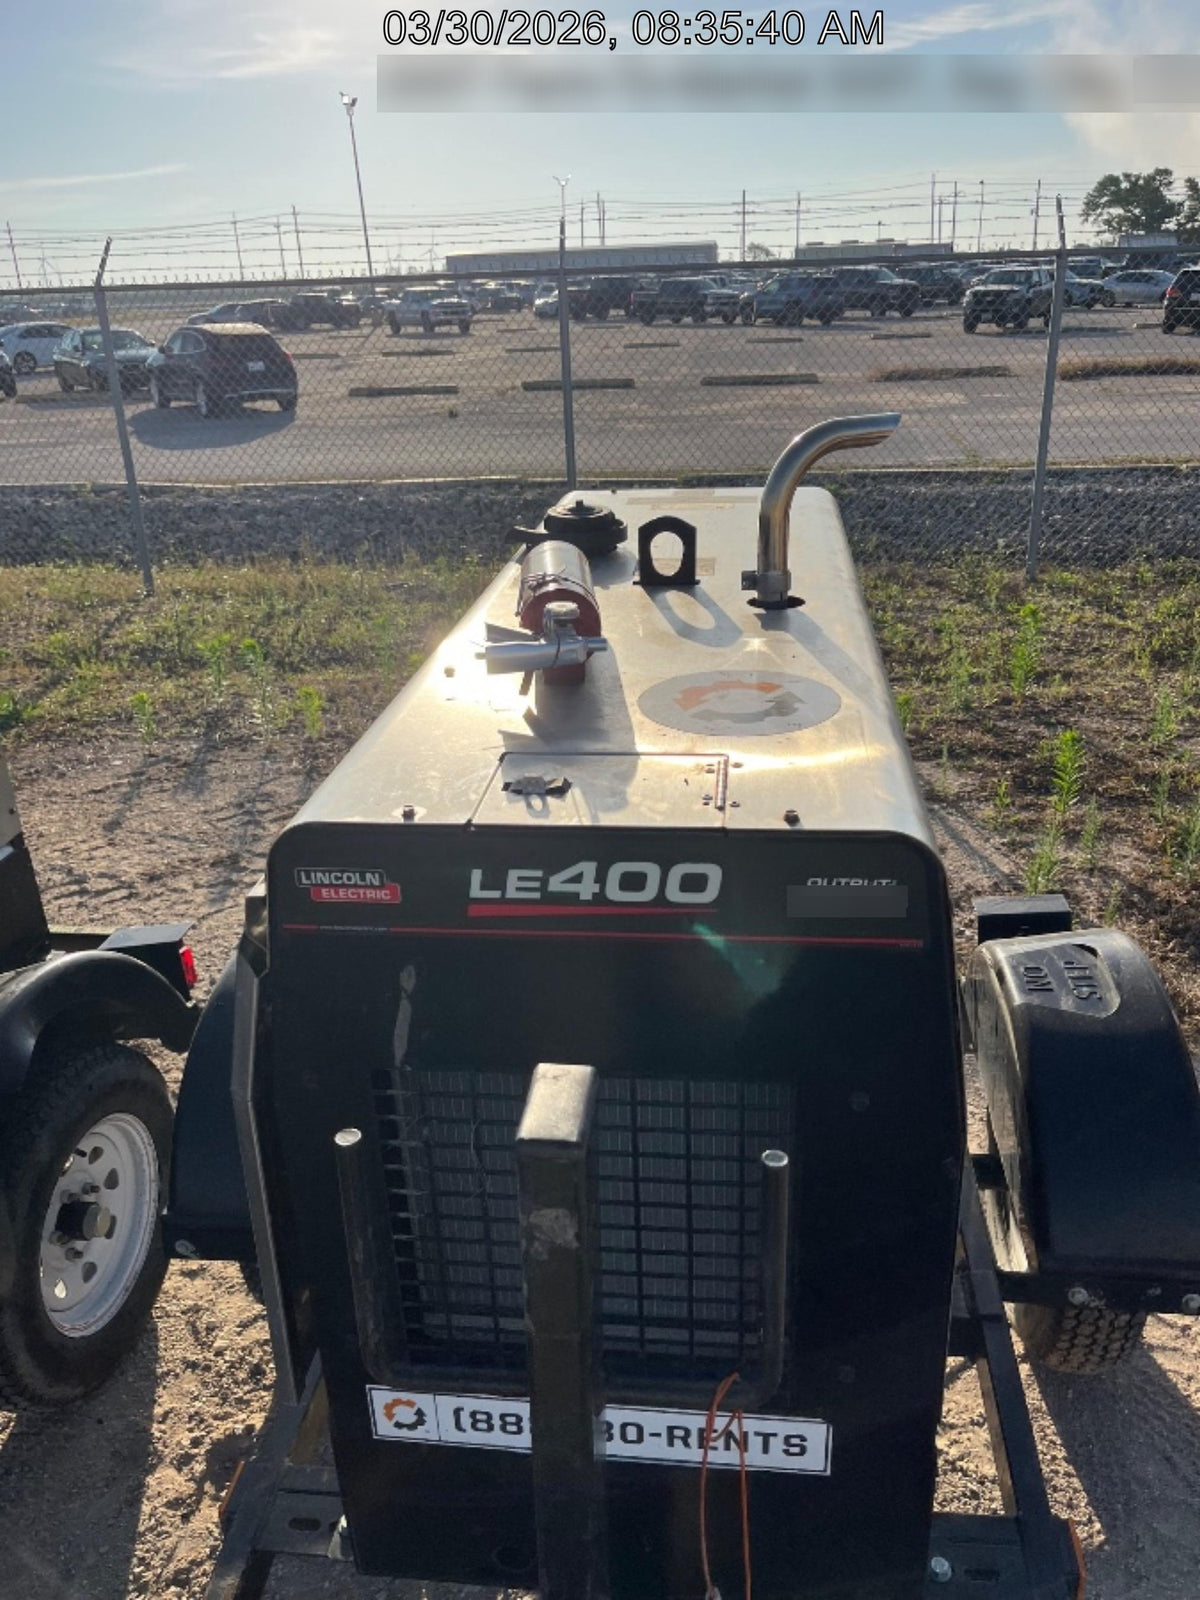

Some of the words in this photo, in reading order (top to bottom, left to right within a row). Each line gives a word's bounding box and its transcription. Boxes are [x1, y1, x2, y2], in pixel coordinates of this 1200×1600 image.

[300, 870, 381, 886] LINCOLN
[469, 861, 723, 903] LE400
[321, 888, 391, 900] ELECTRIC
[1023, 966, 1054, 992] NO
[1063, 961, 1102, 1000] STEP
[453, 1406, 532, 1435] (88
